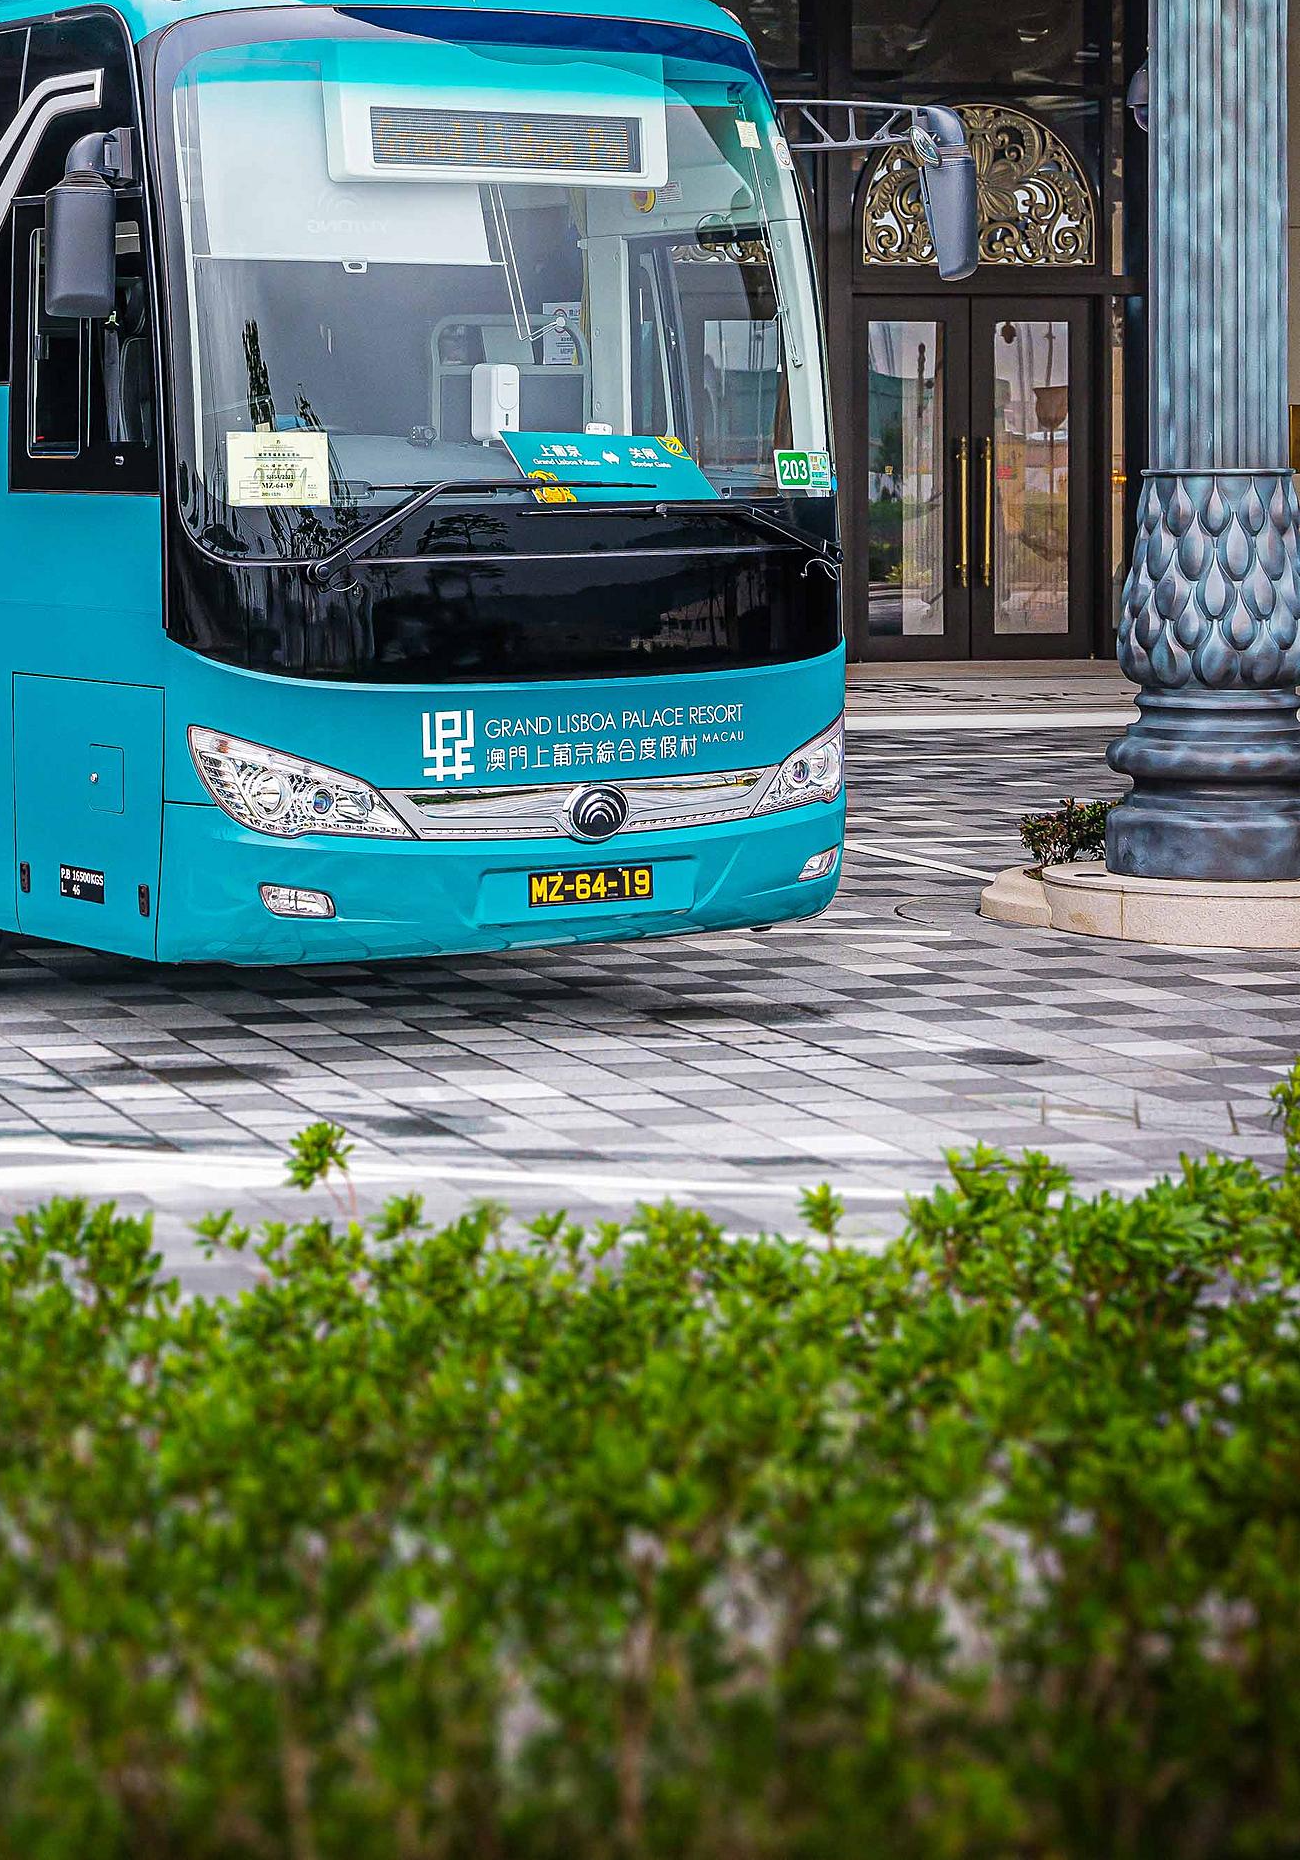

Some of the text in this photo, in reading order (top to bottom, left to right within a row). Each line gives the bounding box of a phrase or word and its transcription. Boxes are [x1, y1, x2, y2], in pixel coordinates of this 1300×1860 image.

[376, 116, 463, 162] Grand
[476, 119, 575, 167] Lisboa
[781, 460, 808, 480] 203
[485, 704, 744, 739] GRAND LISBOA PALACE RESORT
[702, 731, 744, 744] MACAU
[485, 736, 698, 772] 澳門上葡京綜合度假村
[532, 870, 650, 903] MZ-64-19
